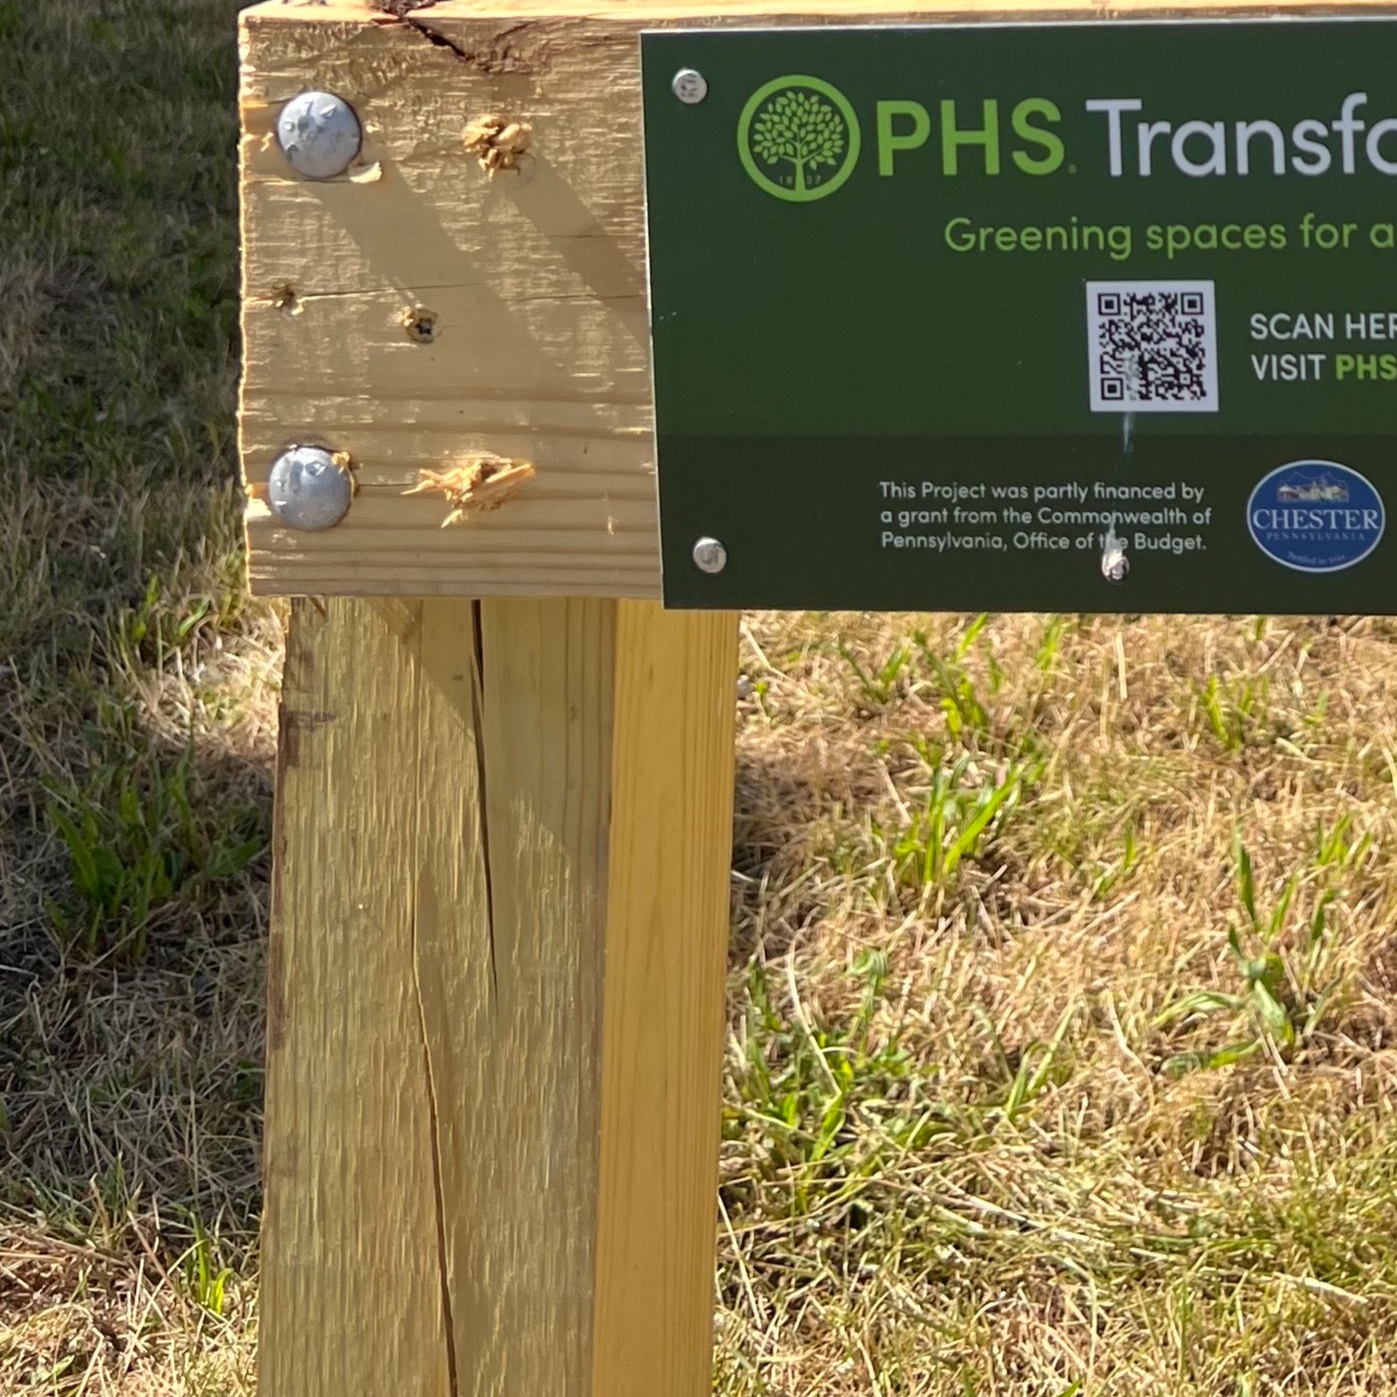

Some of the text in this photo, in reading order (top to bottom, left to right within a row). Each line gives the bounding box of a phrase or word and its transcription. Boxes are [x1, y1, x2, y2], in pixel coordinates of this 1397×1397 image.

[944, 216, 1132, 260] Greening
[1146, 223, 1287, 259] spaces
[1299, 212, 1358, 249] for
[1369, 223, 1395, 248] a
[1250, 312, 1334, 340] SCAN
[1250, 353, 1327, 381] VISIT
[879, 481, 1205, 504] This Project was partly financed by
[880, 506, 1212, 528] a grant from the Commonwealth of
[1252, 508, 1380, 530] CHESTER
[881, 531, 1008, 553] Pennsylvania,
[1013, 531, 1070, 550] Office
[1074, 531, 1095, 550] of
[1134, 532, 1207, 555] Budget.
[1266, 531, 1366, 542] PENNSYLVANIA
